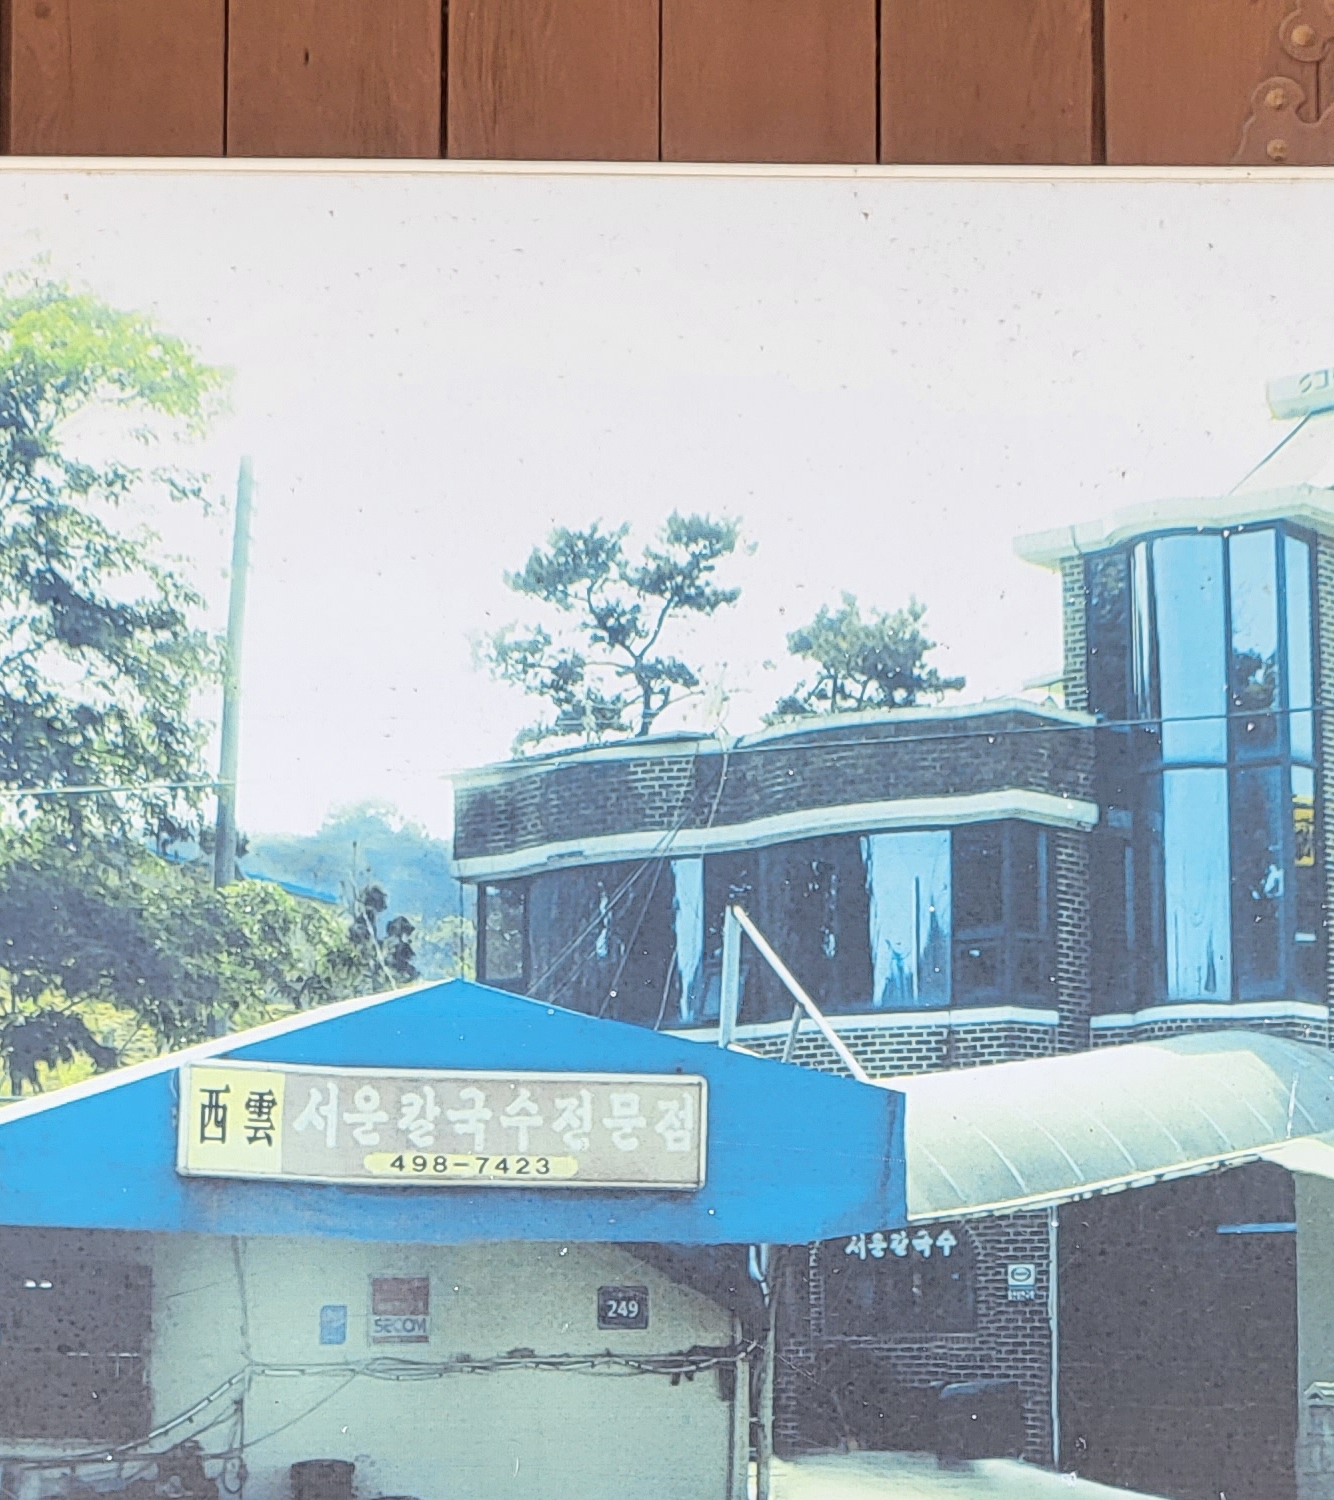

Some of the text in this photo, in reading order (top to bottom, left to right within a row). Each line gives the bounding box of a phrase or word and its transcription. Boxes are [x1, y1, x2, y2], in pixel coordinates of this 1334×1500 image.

[198, 1083, 276, 1148] 西雲
[389, 1154, 551, 1176] 498-7423
[606, 1299, 639, 1318] 249
[374, 1317, 427, 1334] SECOM
